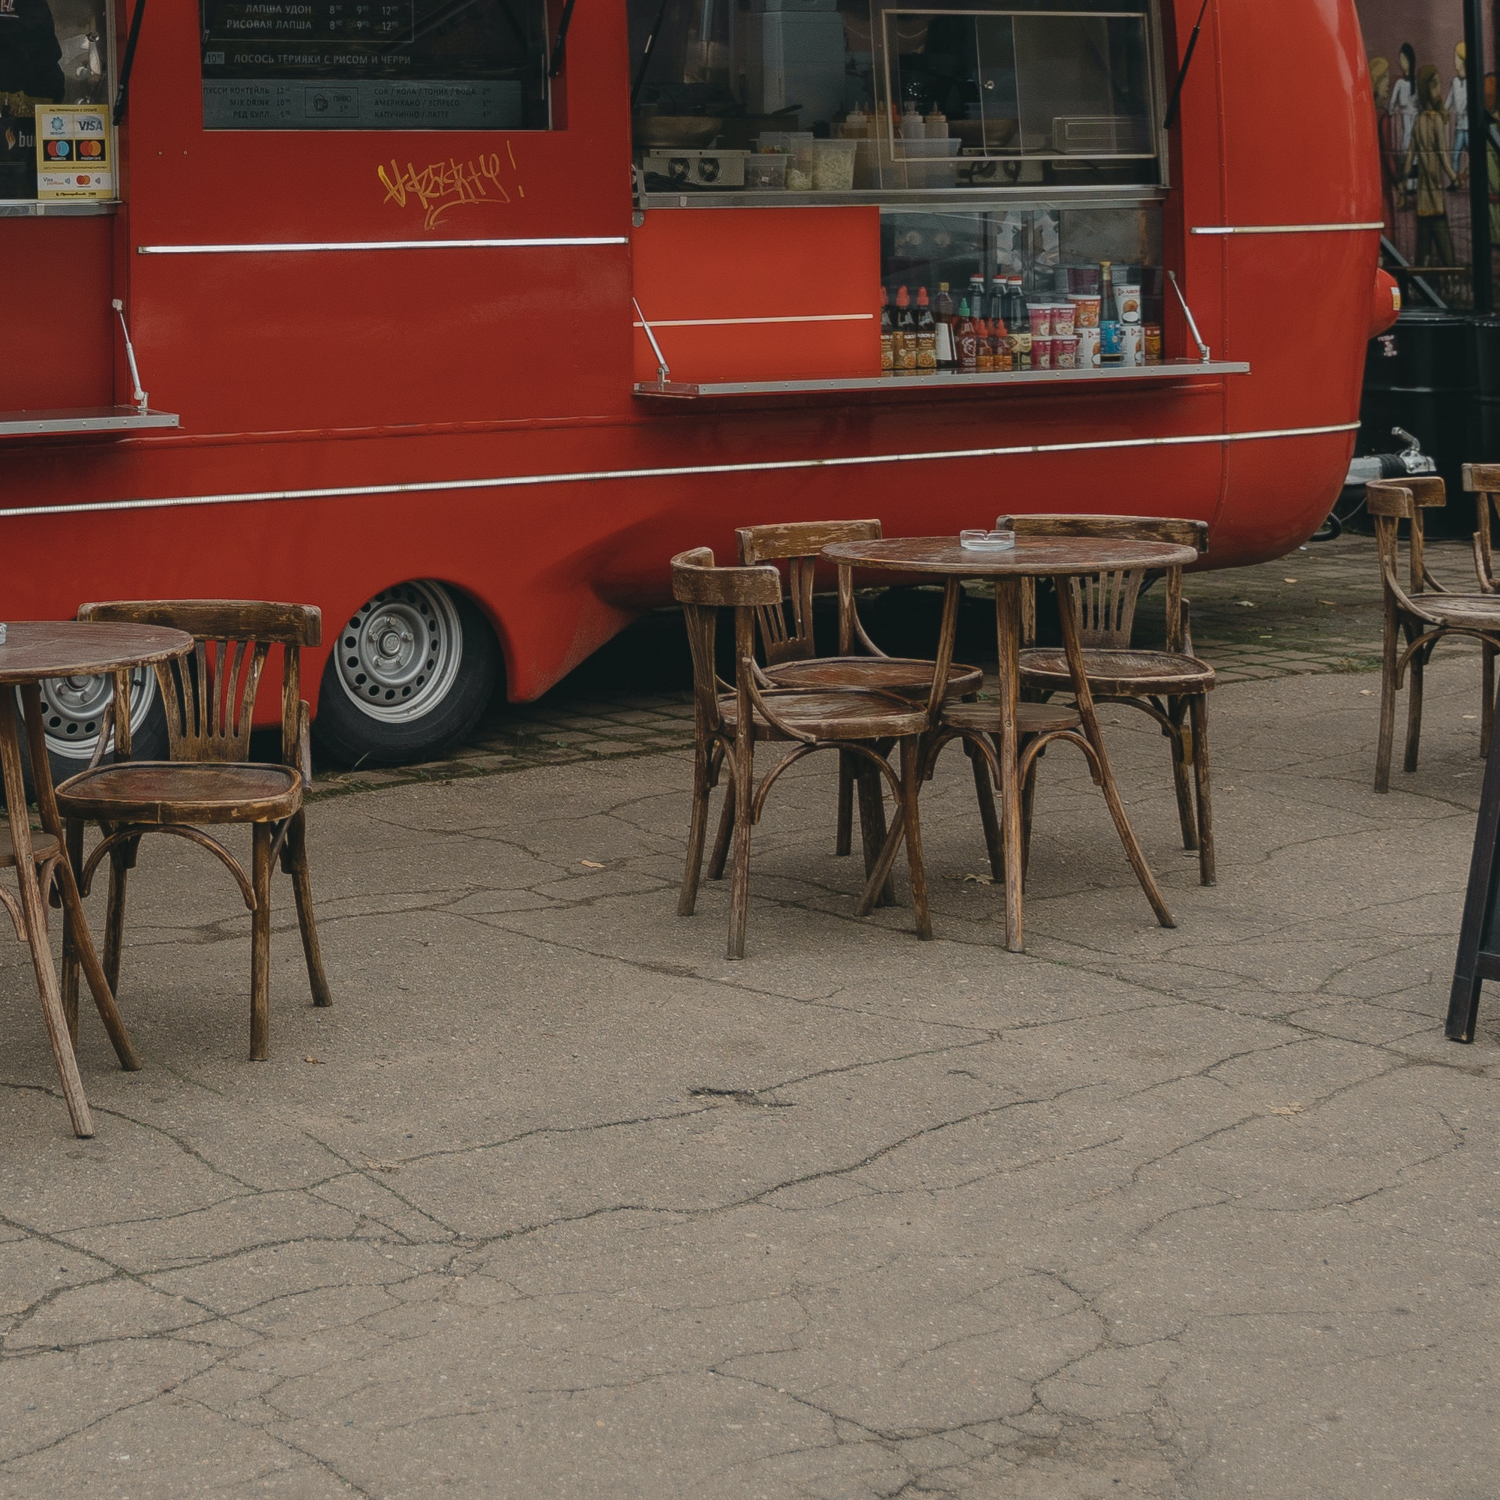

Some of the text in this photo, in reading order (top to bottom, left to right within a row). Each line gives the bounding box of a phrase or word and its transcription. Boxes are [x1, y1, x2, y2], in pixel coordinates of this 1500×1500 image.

[245, 4, 282, 14] ЛАПША
[285, 5, 312, 15] УДОН
[226, 19, 273, 29] РИСОВАЯ
[275, 20, 312, 30] ЛАПША
[233, 54, 275, 64] ЛОСОСЬ
[278, 54, 321, 64] ТЕРИЯКИ
[323, 55, 330, 65] С
[332, 55, 368, 65] РИСОМ
[371, 55, 378, 65] И
[380, 55, 411, 66] ЧЕРРИ
[77, 120, 103, 131] VISA
